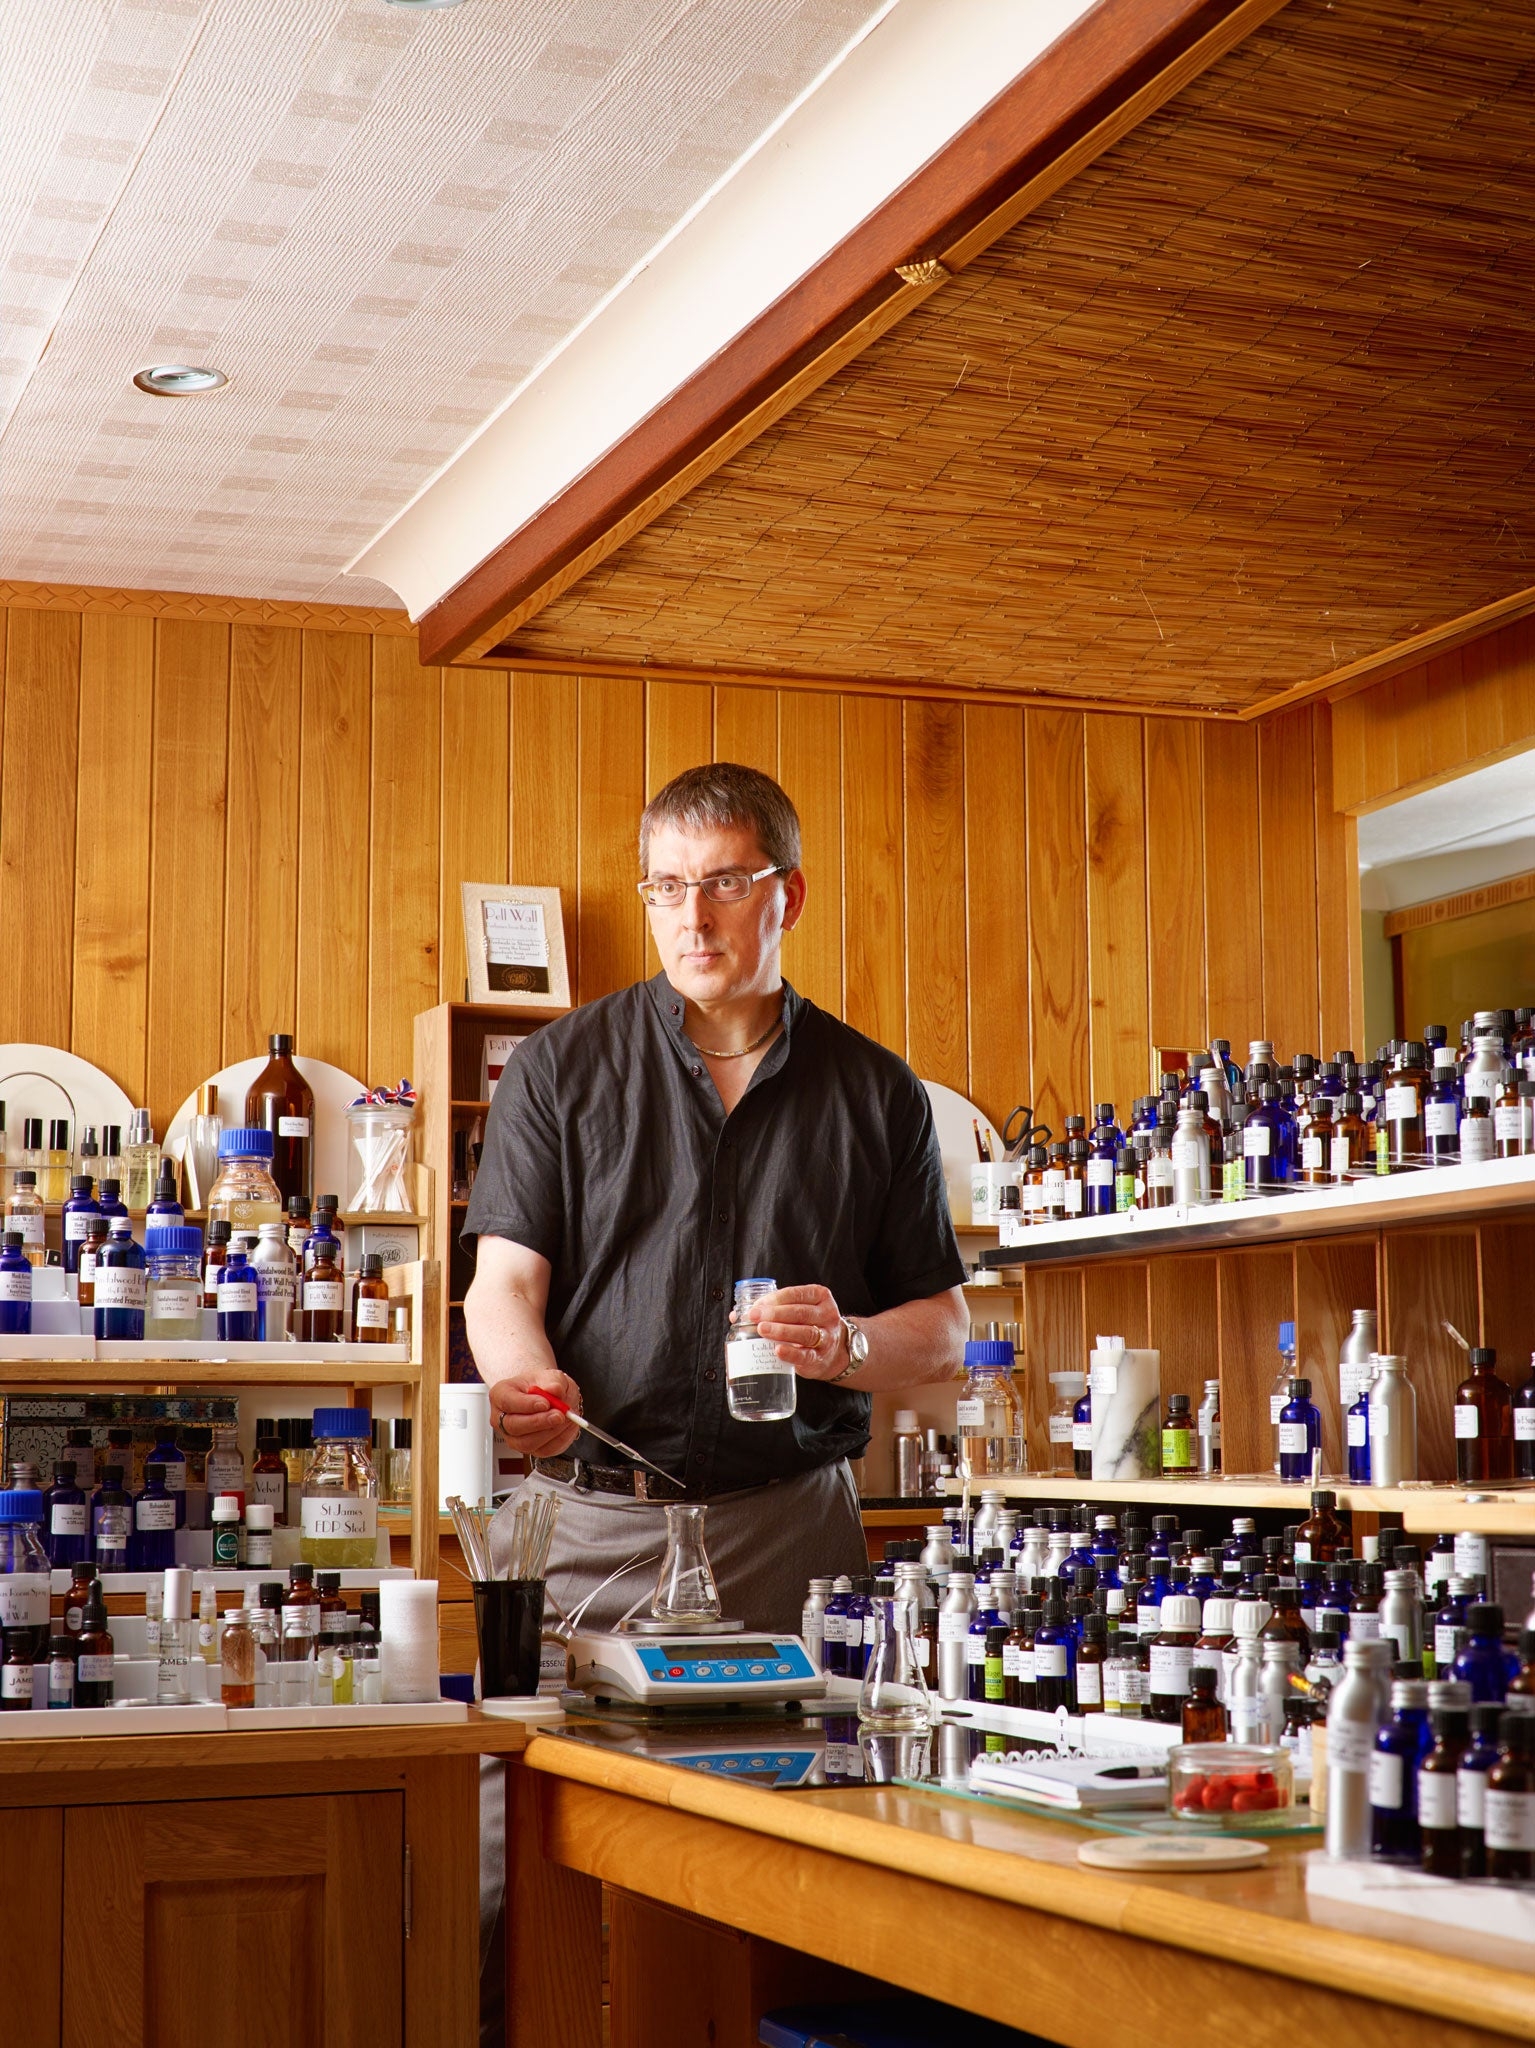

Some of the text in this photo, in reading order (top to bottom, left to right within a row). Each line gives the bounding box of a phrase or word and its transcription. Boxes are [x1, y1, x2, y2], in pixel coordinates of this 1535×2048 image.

[485, 907, 538, 923] Pell Wall
[489, 1040, 507, 1050] Pell
[257, 1266, 286, 1275] Sandalwood
[262, 1277, 272, 1286] Pell
[273, 1277, 284, 1286] Wall
[255, 1481, 281, 1493] Velvet
[321, 1503, 363, 1516] St James
[159, 1657, 188, 1668] JAMES
[9, 1677, 33, 1686] JAME
